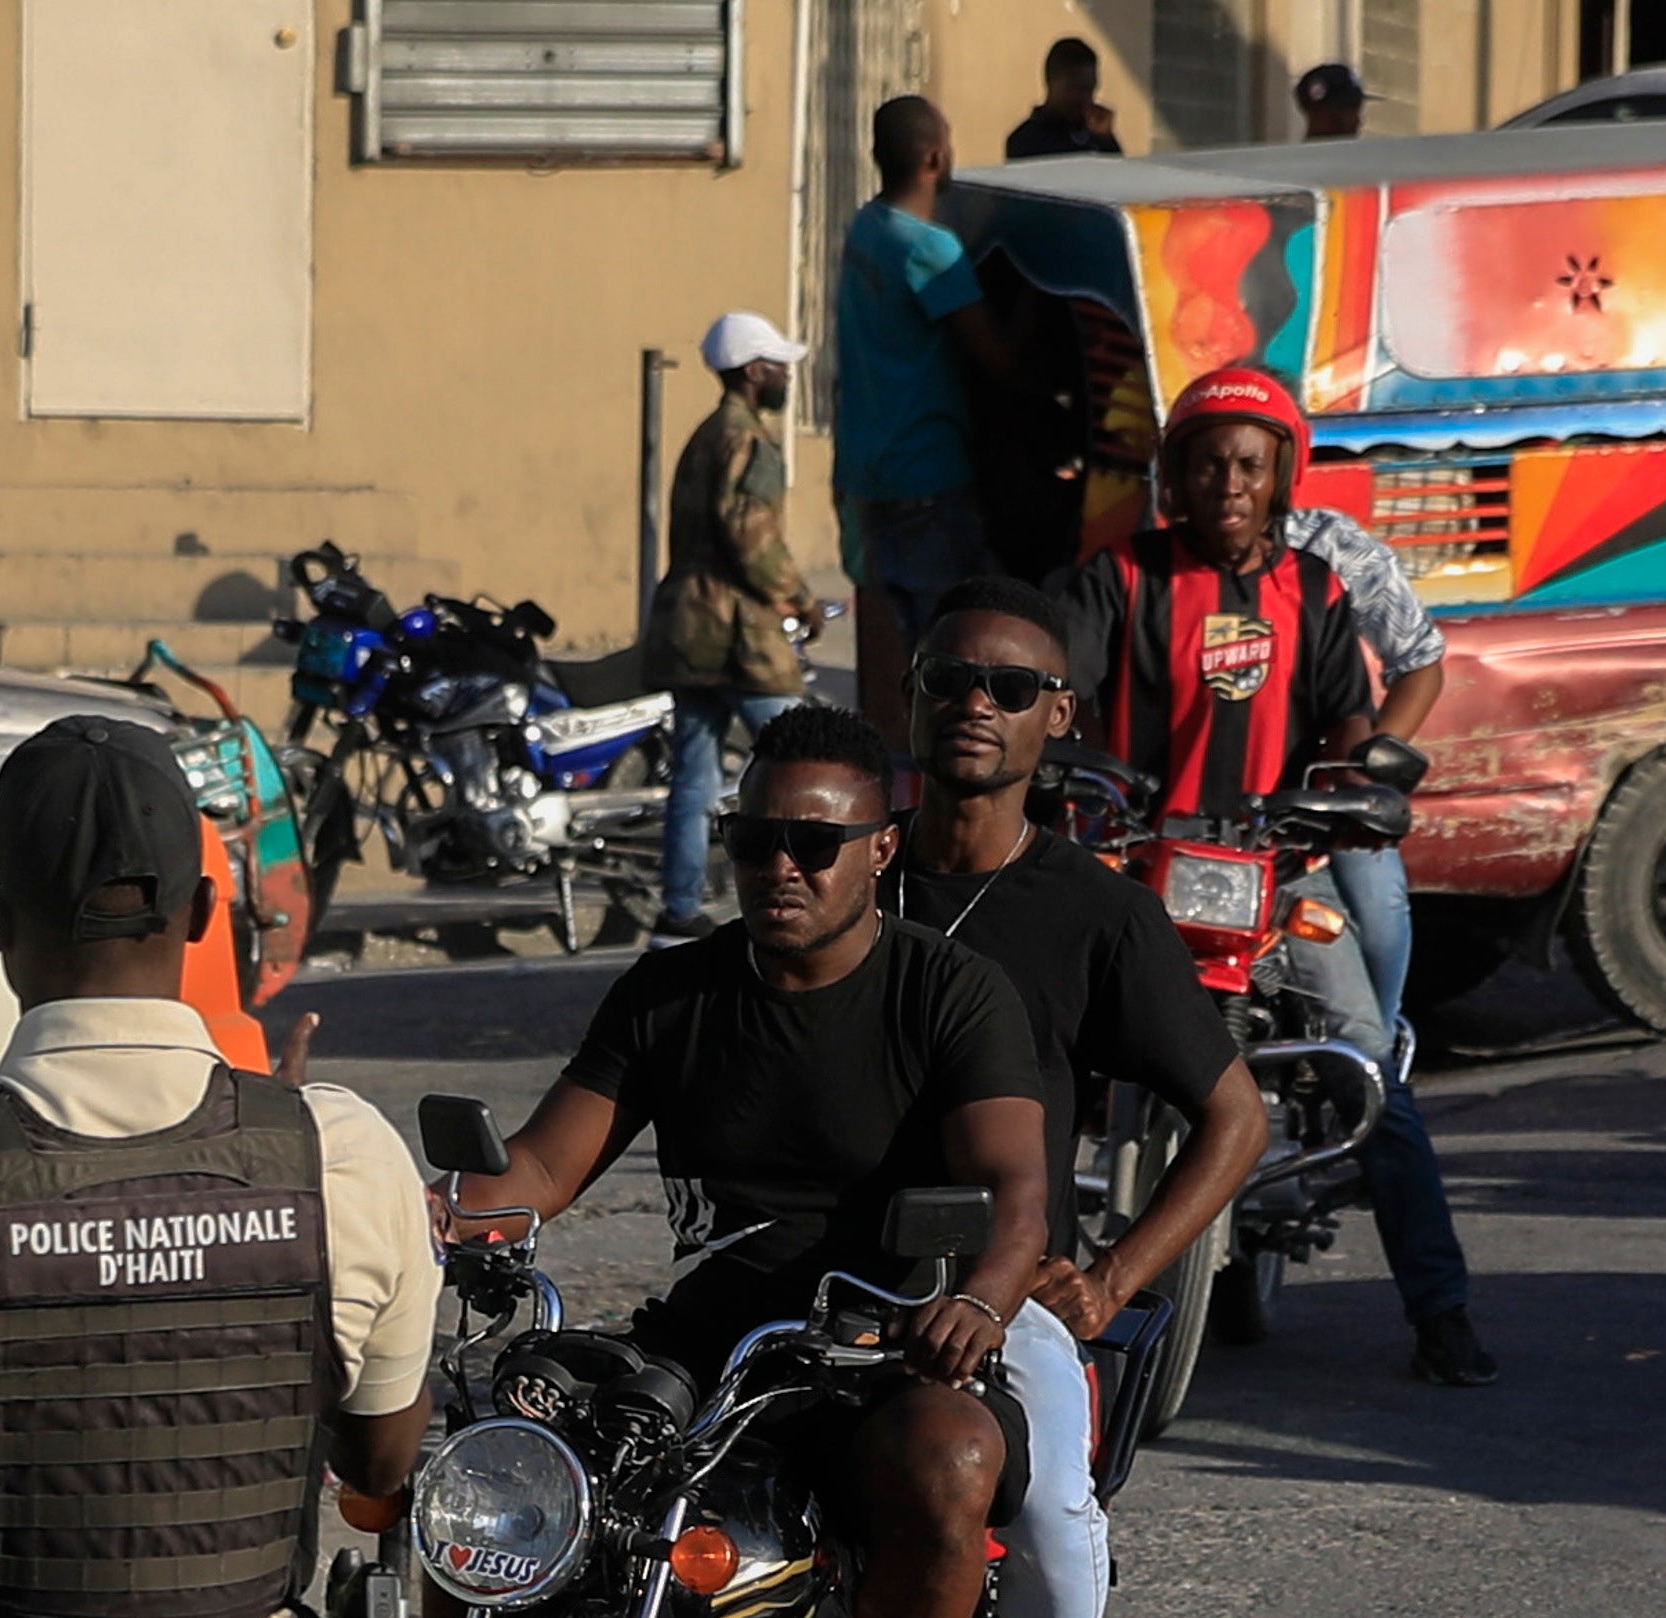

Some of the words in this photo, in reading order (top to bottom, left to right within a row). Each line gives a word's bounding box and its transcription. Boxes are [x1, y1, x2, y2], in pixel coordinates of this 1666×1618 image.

[1205, 384, 1270, 403] Apollo
[1201, 640, 1273, 672] UPWARD
[9, 1219, 116, 1256] POLICE
[123, 1207, 298, 1251] NATIONALE
[97, 1248, 206, 1287] D'HAITI
[465, 1548, 539, 1584] JESUS
